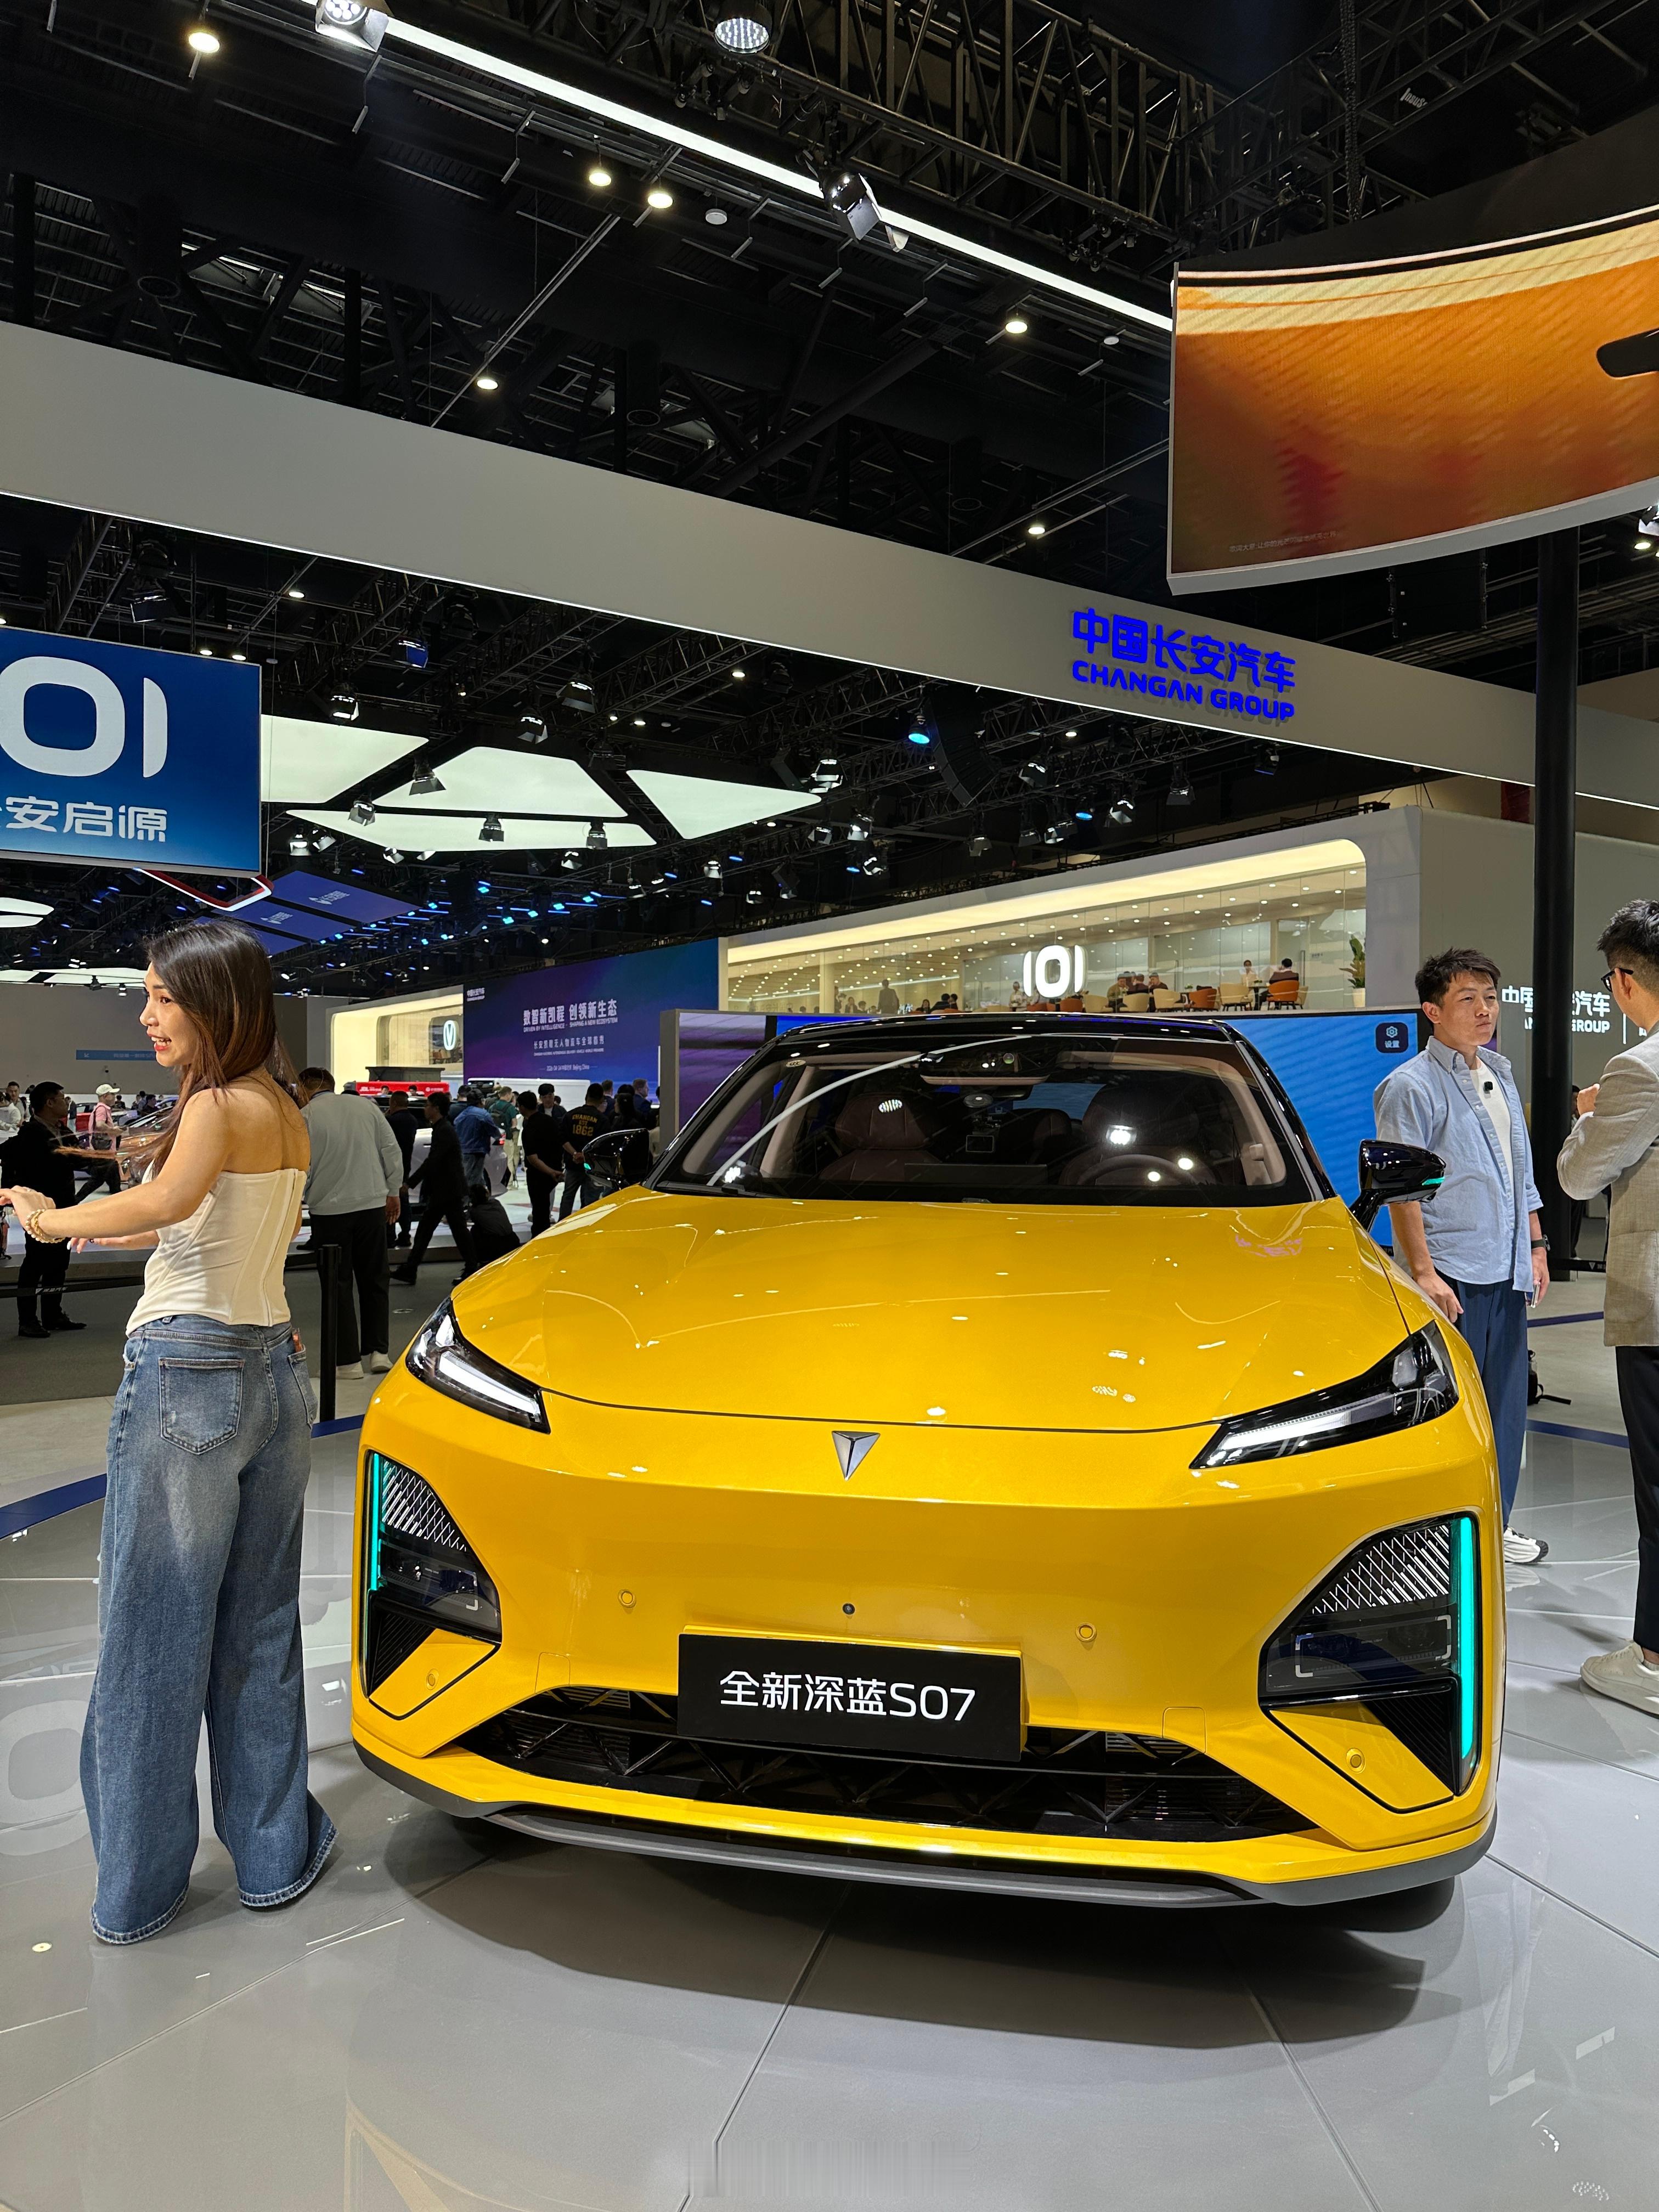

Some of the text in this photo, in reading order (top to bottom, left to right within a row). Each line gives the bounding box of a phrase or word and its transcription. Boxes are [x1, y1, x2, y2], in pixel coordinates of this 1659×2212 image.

[1073, 607, 1296, 693] 中国长安汽车
[1072, 660, 1295, 721] CHANGAN GROUP
[0, 795, 168, 843] 安启源
[569, 998, 617, 1021] 创领新生态
[572, 1114, 598, 1124] CHANGAN
[572, 1124, 594, 1137] 1862
[719, 1671, 976, 1722] 全新深蓝S07
